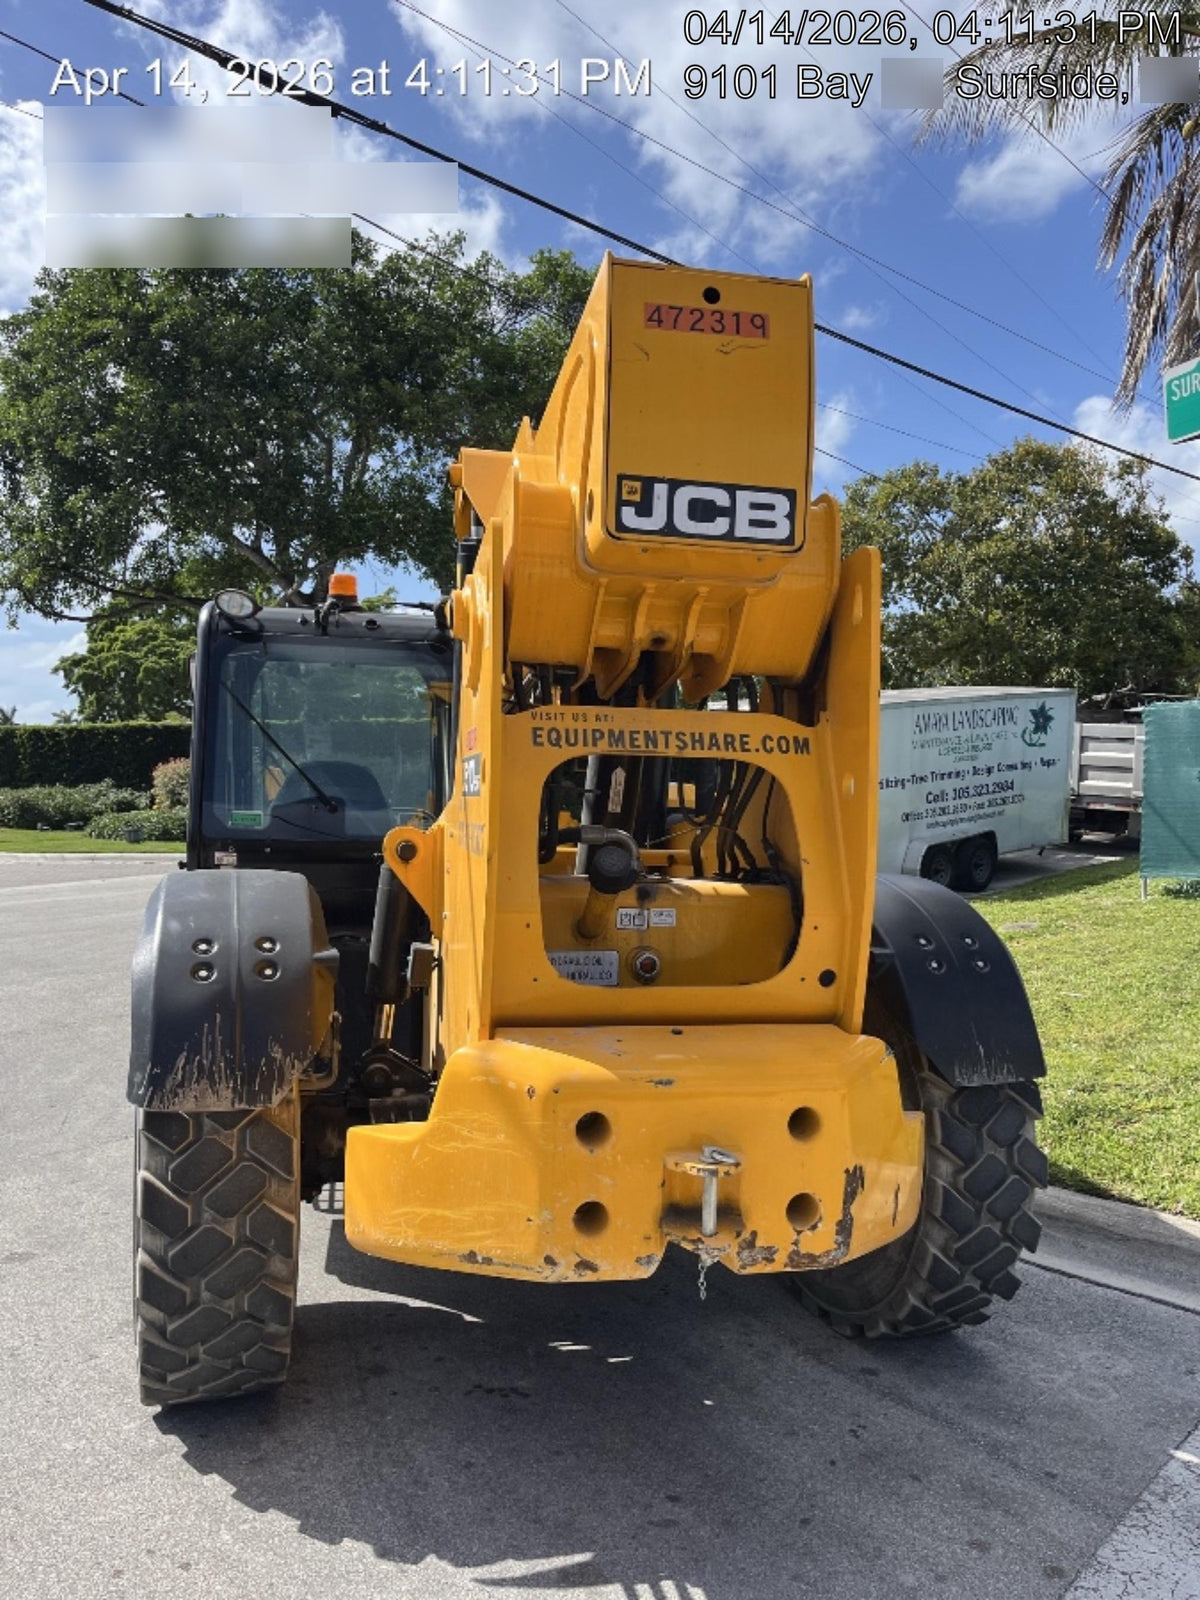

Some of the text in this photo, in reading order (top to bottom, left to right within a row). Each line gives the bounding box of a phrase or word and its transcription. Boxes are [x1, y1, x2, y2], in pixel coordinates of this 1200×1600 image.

[647, 304, 767, 339] 472319
[621, 482, 792, 541] JCB
[531, 711, 566, 721] VISIT
[572, 712, 588, 722] US
[531, 726, 812, 755] EQUIPMENTSHARE.COM
